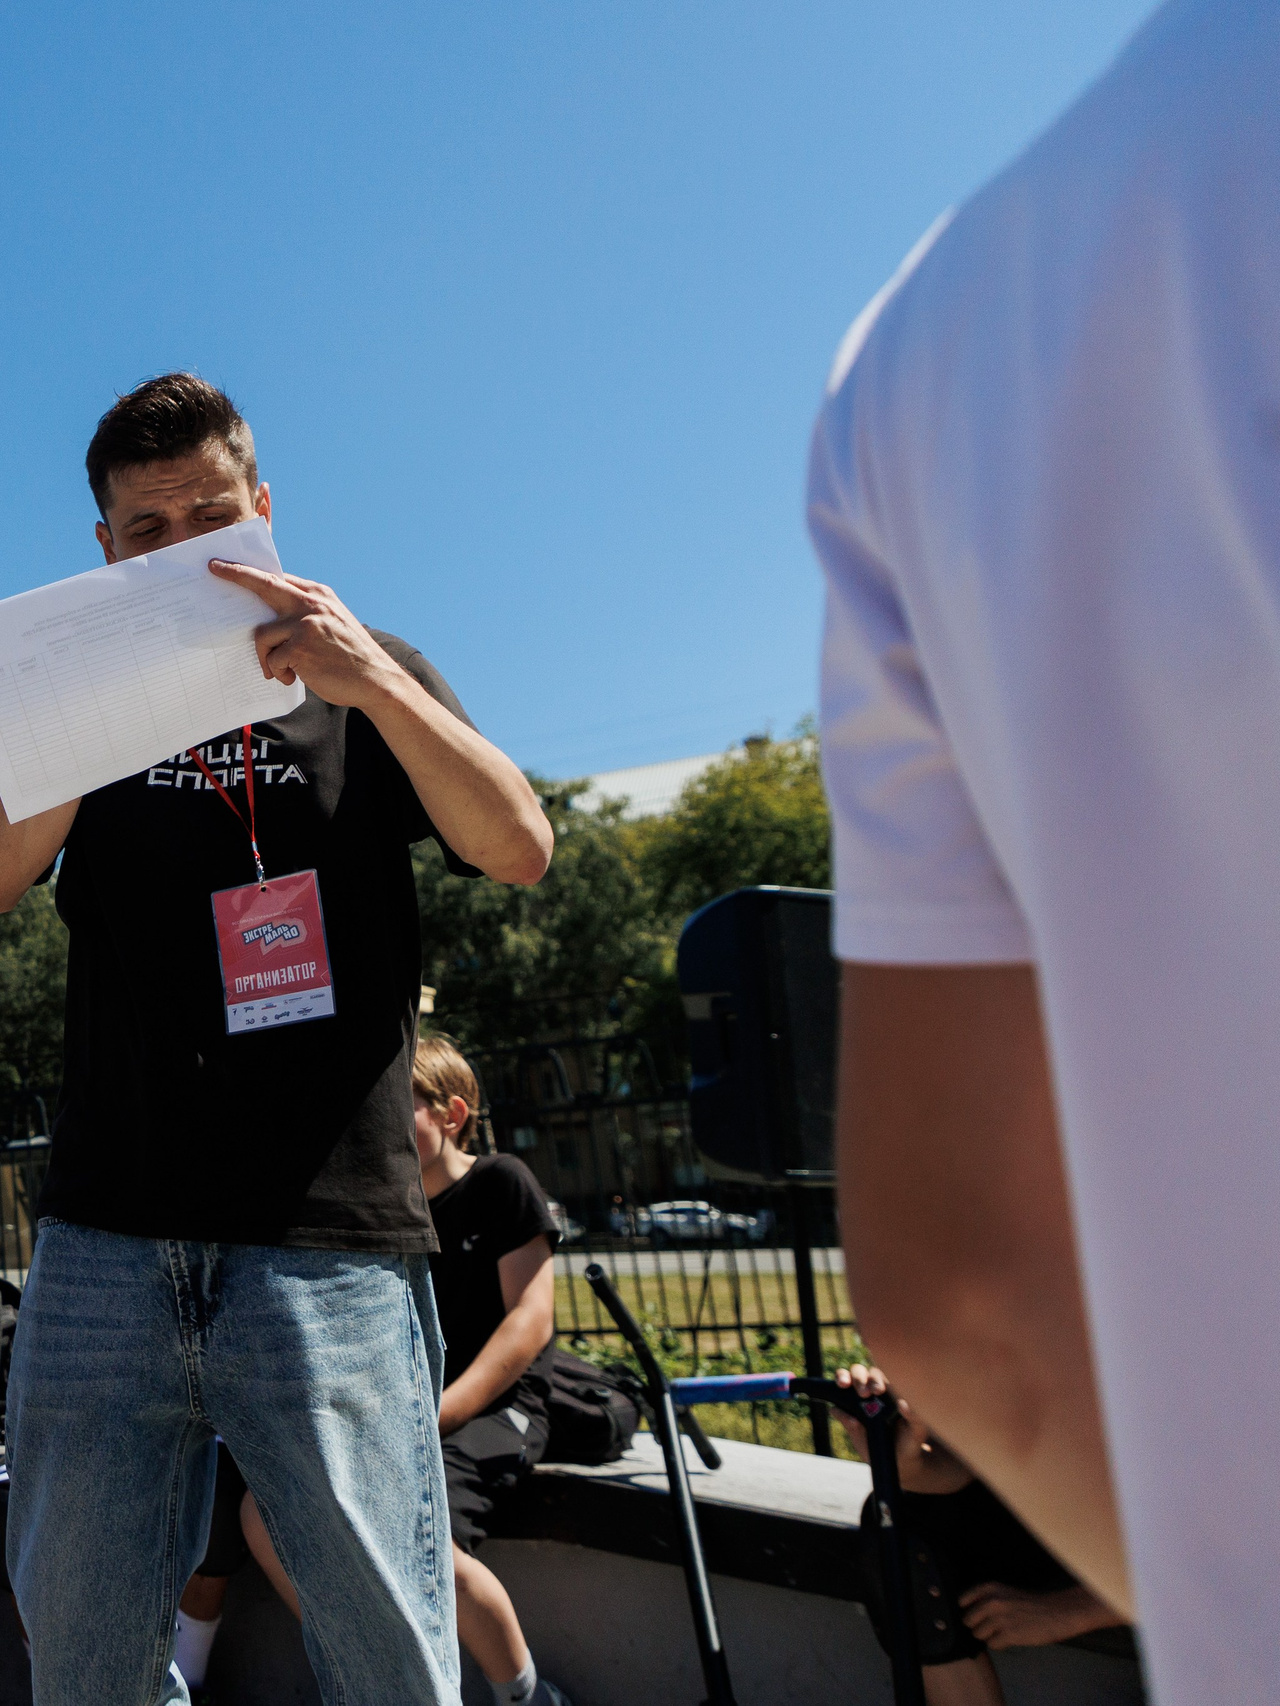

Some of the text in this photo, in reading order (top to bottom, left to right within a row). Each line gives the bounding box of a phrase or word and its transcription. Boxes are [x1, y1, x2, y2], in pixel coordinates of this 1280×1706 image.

[243, 923, 273, 943] ЭКСТРЕ
[264, 925, 289, 944] МАЛЬ
[283, 926, 299, 940] НО
[235, 961, 317, 994] ОРГАНИЗАТОР
